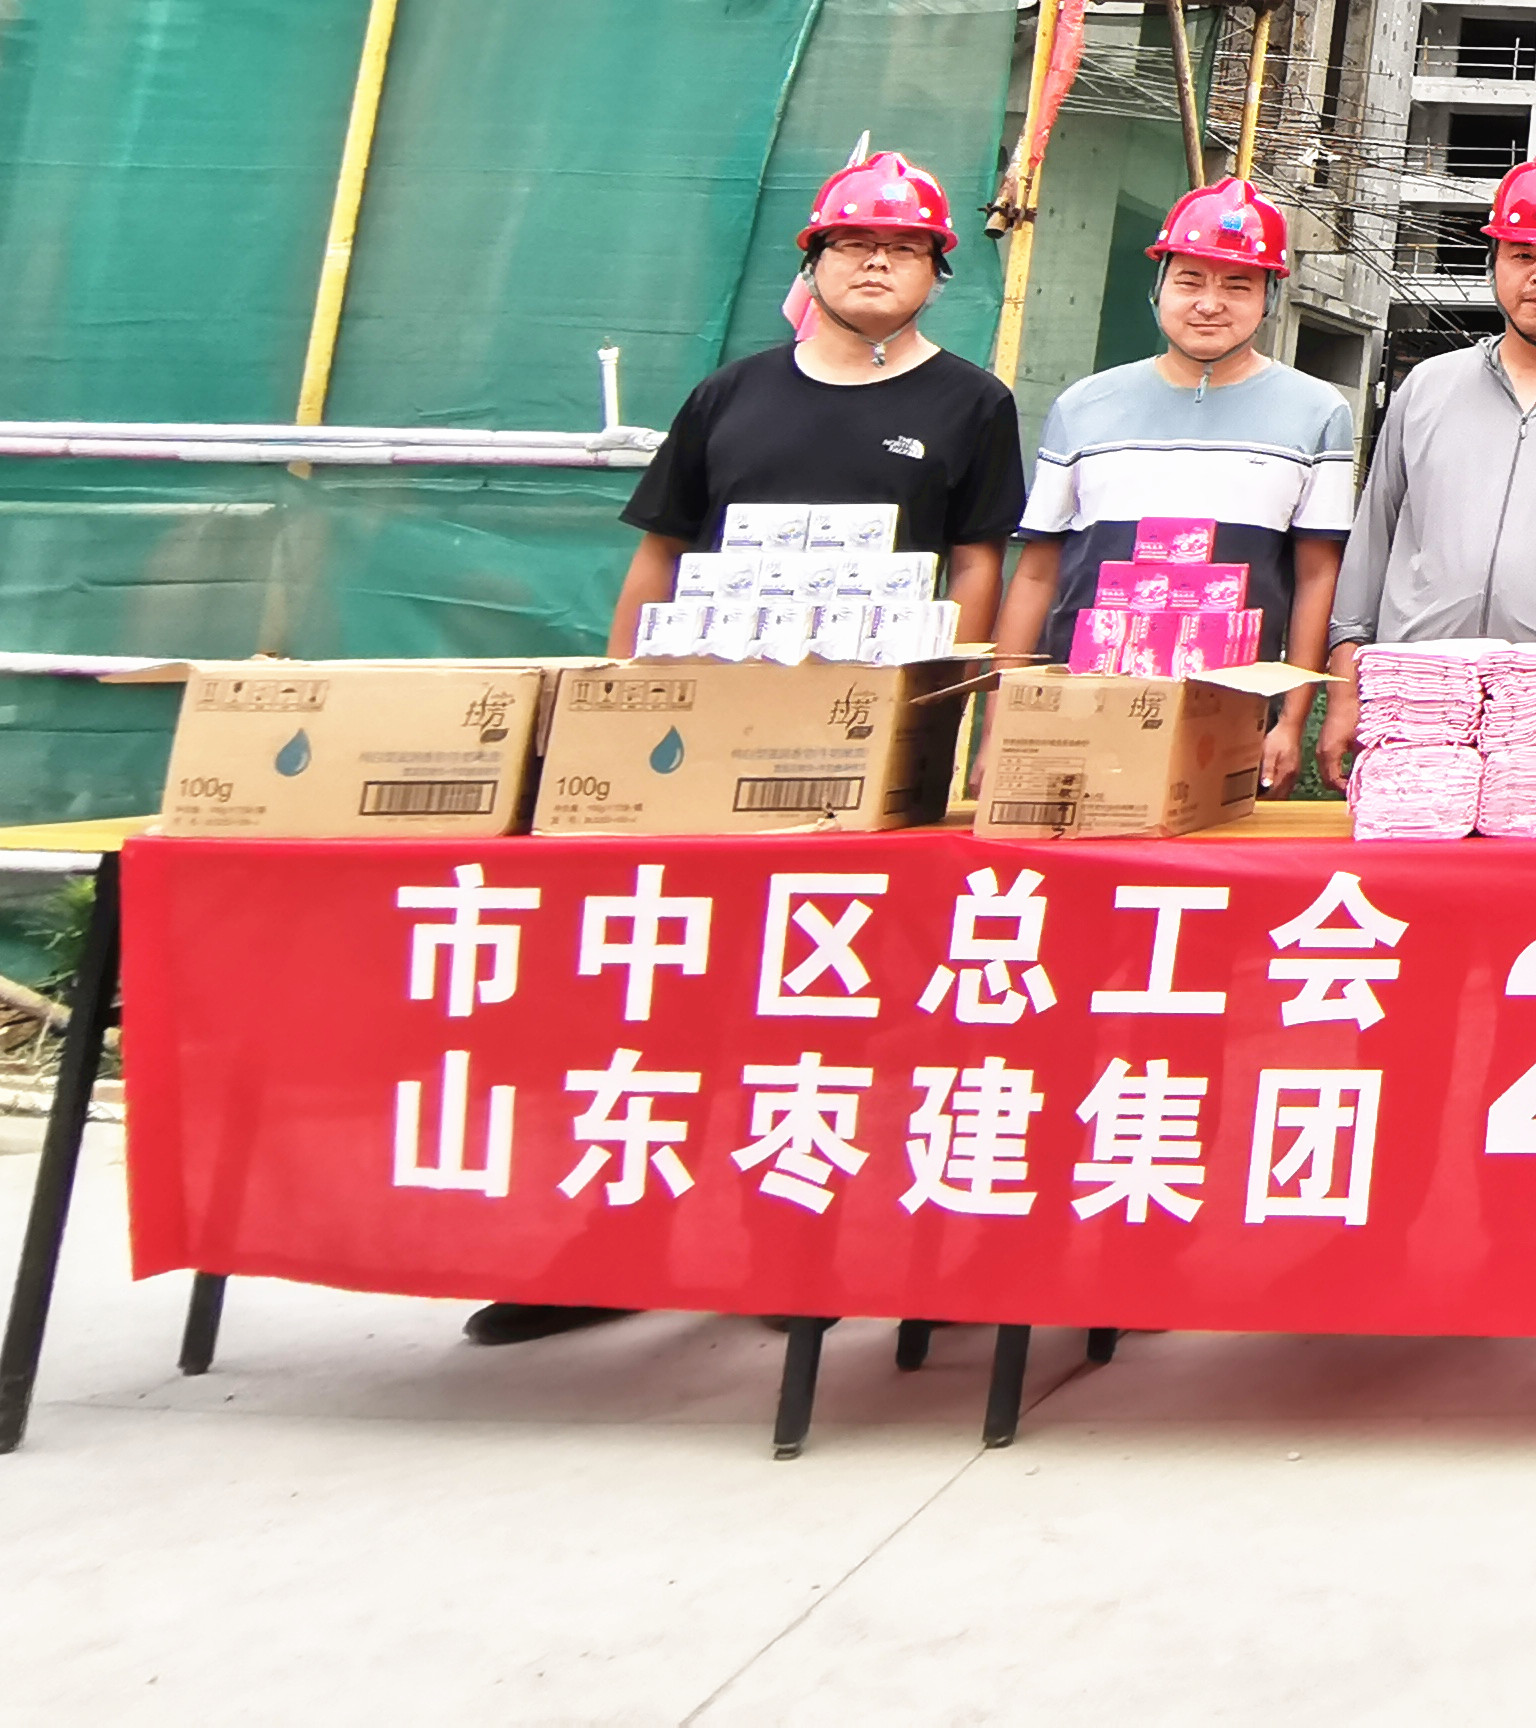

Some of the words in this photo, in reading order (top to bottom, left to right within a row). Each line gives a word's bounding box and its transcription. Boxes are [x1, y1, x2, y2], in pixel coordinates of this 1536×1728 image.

[180, 777, 233, 802] 100g
[556, 775, 611, 801] 100g
[395, 863, 1409, 1031] 市中区总工会
[395, 1047, 1384, 1228] 山东枣建集团
